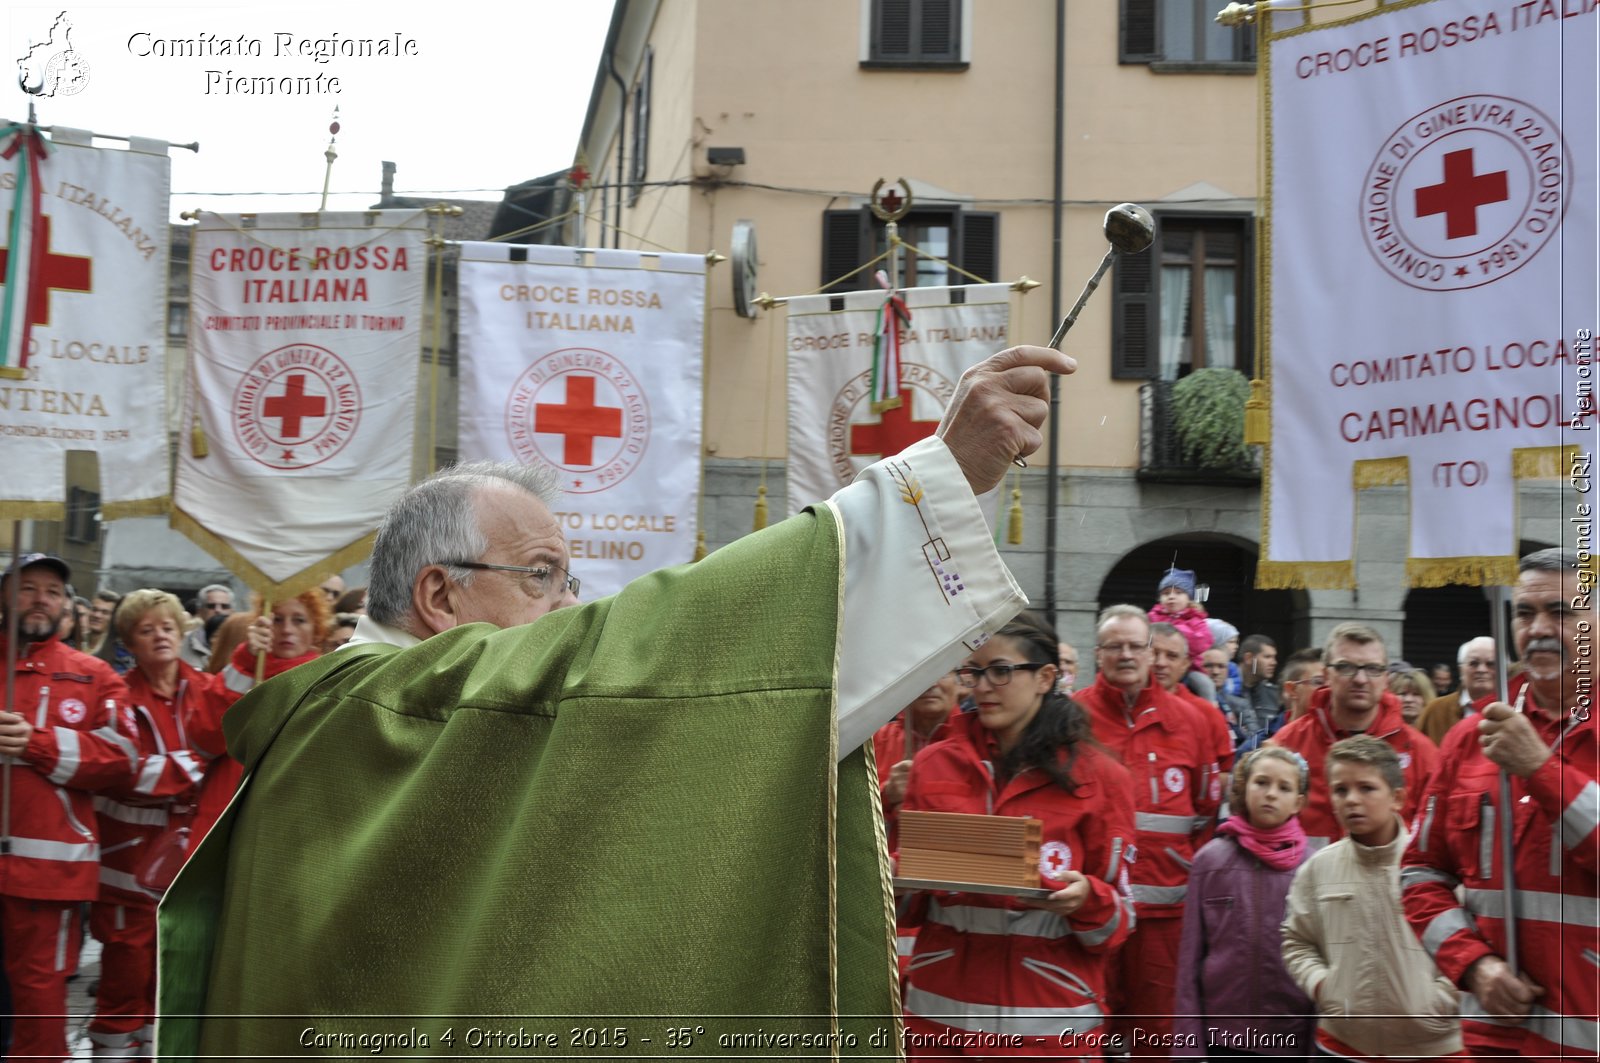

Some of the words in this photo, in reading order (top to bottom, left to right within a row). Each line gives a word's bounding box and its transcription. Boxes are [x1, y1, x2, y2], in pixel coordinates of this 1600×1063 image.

[1296, 37, 1390, 79] CROCE
[1400, 12, 1501, 57] ROSSA
[1415, 103, 1516, 139] GINEVRA
[1513, 118, 1544, 144] 22
[1389, 136, 1415, 159] DI
[1526, 143, 1562, 234] AGOSTO
[56, 181, 158, 260] ITALIANA
[1368, 162, 1445, 282] CONVENZIONE
[210, 247, 302, 272] CROCE
[314, 246, 408, 272] ROSSA
[1478, 238, 1529, 274] 1864
[242, 278, 369, 303] ITALIANA
[500, 284, 580, 304] CROCE
[588, 288, 662, 309] ROSSA
[266, 314, 341, 331] PROVINCIALE
[526, 311, 635, 334] ITALIANA
[50, 339, 149, 364] LOCALE
[791, 333, 850, 351] CROCE
[926, 326, 1008, 343] ITALIANA
[1330, 346, 1476, 387] COMITATO
[548, 353, 613, 372] GINEVRA
[627, 394, 645, 454] AGOSTO
[1433, 460, 1488, 488] (TO)
[591, 514, 676, 533] LOCALE
[570, 540, 644, 561] ELINO
